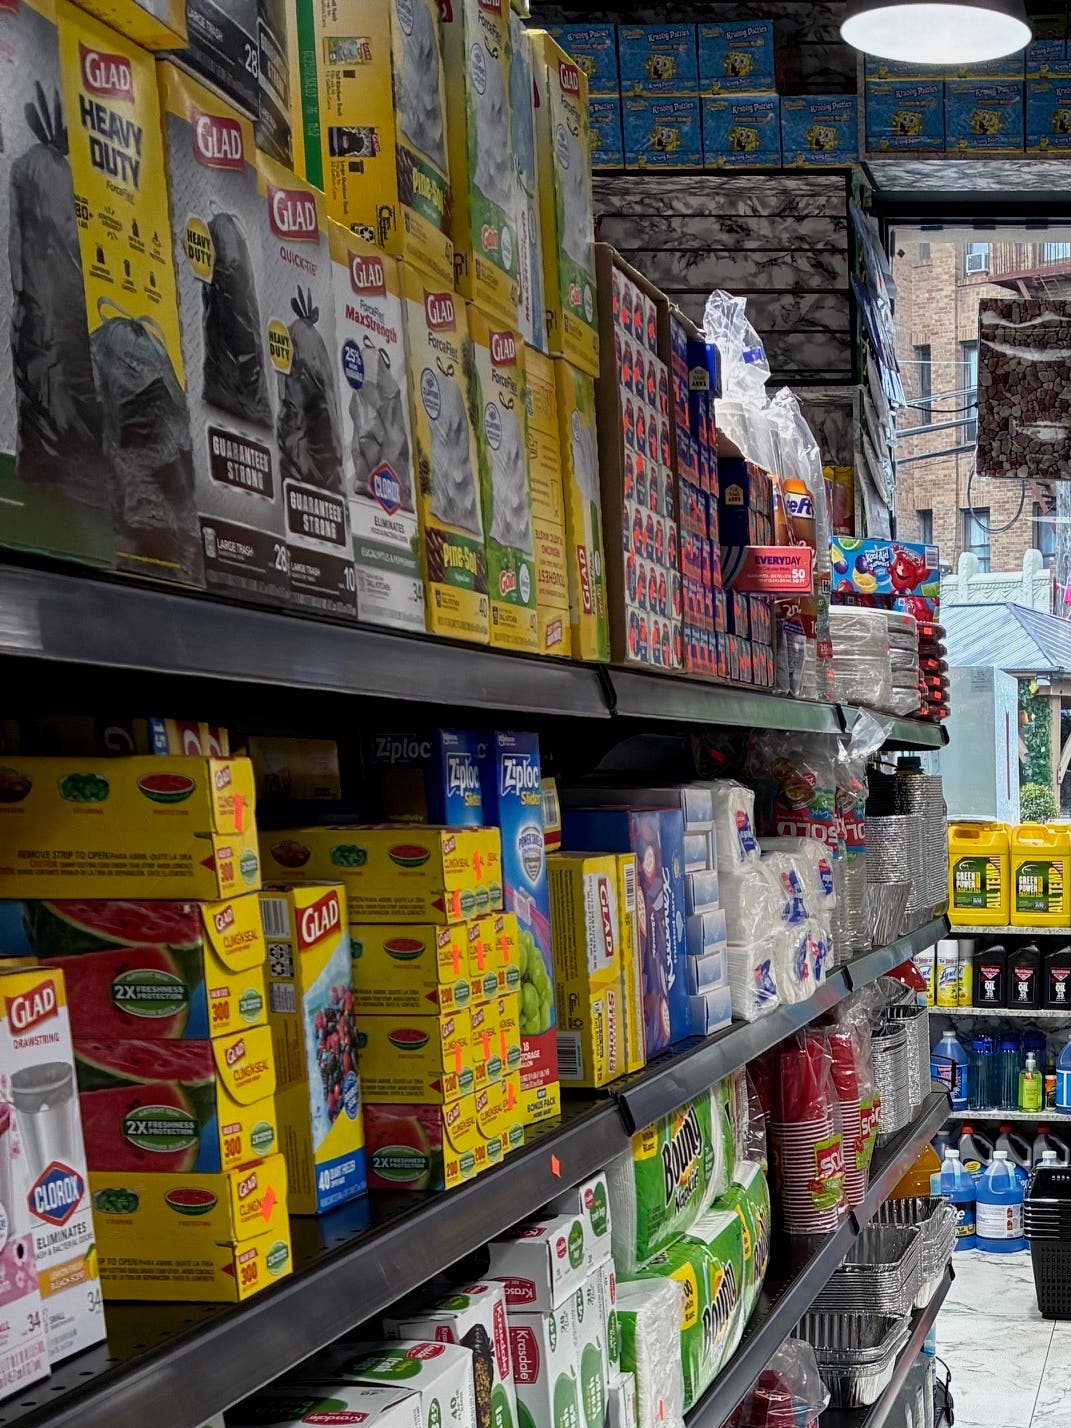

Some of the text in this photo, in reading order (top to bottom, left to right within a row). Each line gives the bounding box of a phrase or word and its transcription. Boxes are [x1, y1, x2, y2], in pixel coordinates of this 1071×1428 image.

[85, 54, 130, 90] GLAD
[560, 65, 579, 91] GLAD
[79, 94, 143, 156] HEAVY
[197, 117, 242, 159] GLAD
[89, 135, 140, 189] DUTY
[273, 191, 315, 232] GLAD
[187, 228, 211, 247] HEAVY
[188, 244, 212, 267] DUTY
[353, 260, 383, 290] GLAD
[427, 295, 453, 324] GLAD
[268, 329, 290, 347] HEAVY
[345, 304, 398, 344] MaxStrength
[271, 342, 290, 361] DUTY
[491, 336, 515, 360] GLAD
[227, 463, 264, 490] STRONG
[303, 515, 337, 538] STRONG
[274, 544, 287, 572] 28
[754, 555, 801, 567] EVERYDAY
[343, 566, 355, 591] 10
[792, 568, 806, 579] 50
[376, 738, 431, 763] Ziploc
[450, 759, 479, 796] Ziploc
[504, 759, 538, 796] Ziploc
[302, 900, 339, 943] GLAD
[600, 884, 613, 953] GLAD
[114, 985, 134, 1000] 2X
[10, 988, 55, 1027] GLAD
[126, 1120, 147, 1135] 2X
[34, 1176, 83, 1214] CLOROX
[318, 1172, 330, 1192] 40
[36, 1222, 87, 1250] ELIMINATES
[518, 1330, 531, 1382] Krasdale
